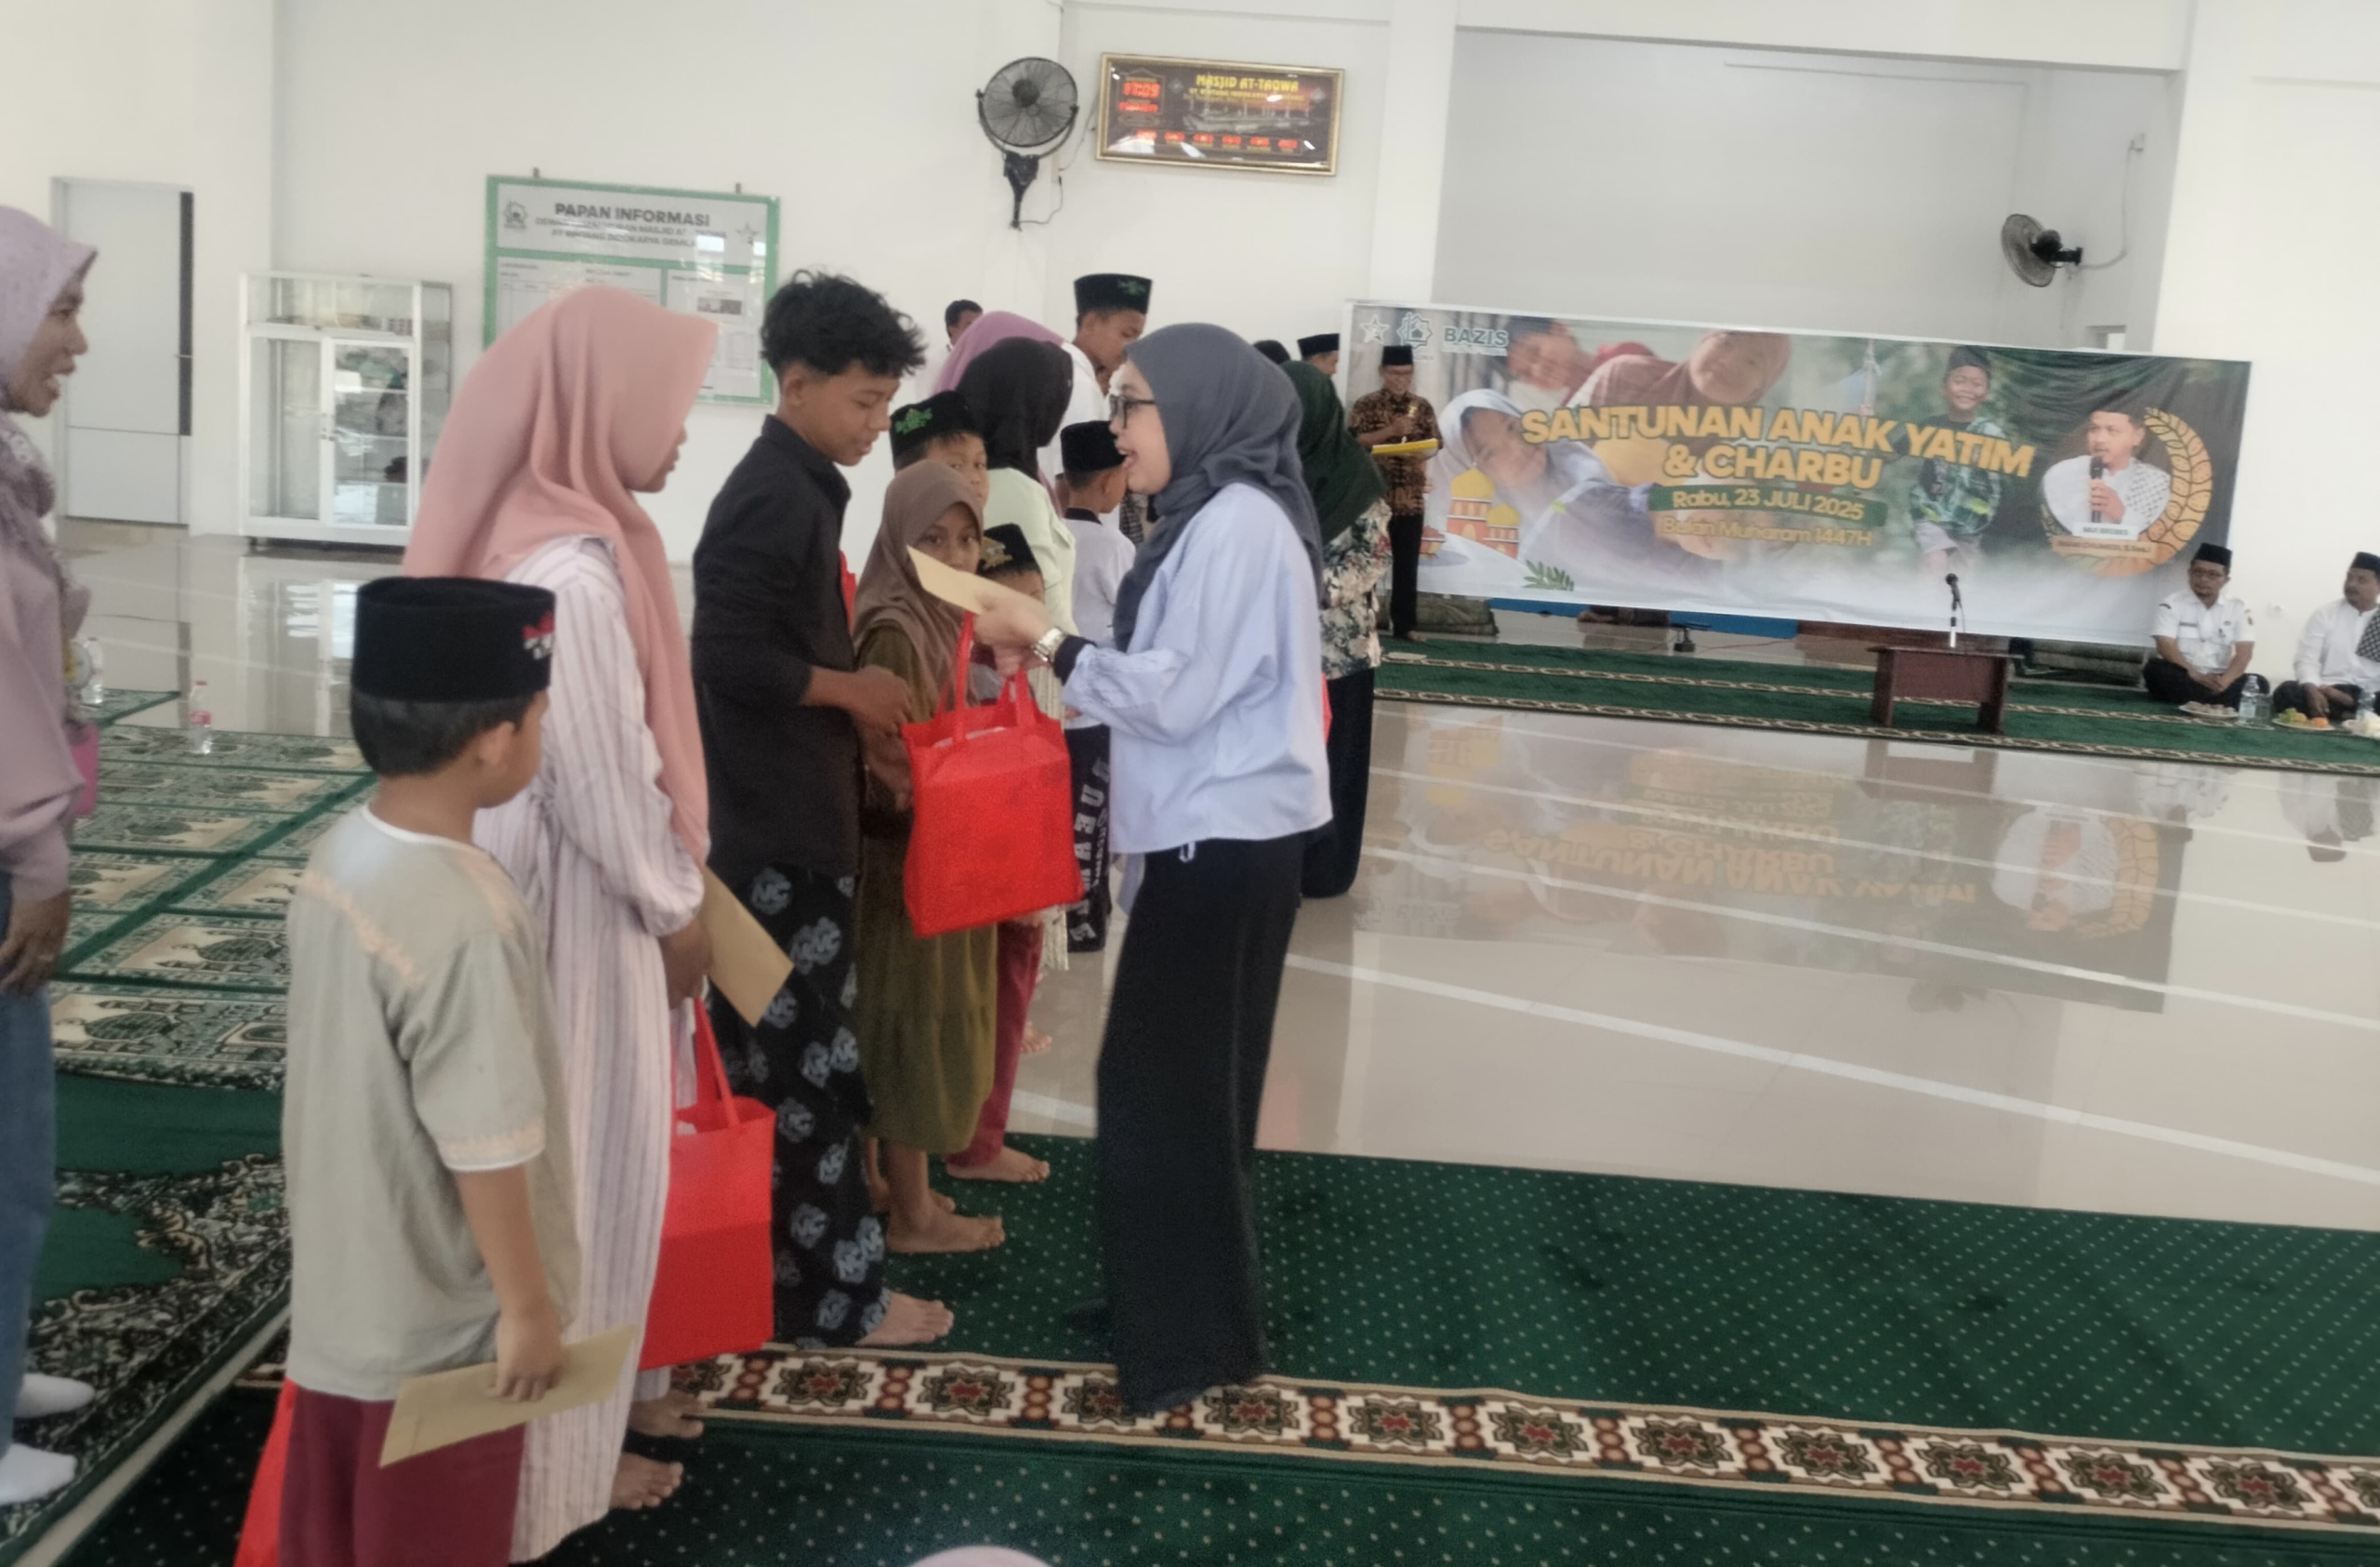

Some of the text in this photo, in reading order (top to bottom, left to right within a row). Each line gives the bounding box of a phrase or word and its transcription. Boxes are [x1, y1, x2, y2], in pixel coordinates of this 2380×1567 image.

[1196, 74, 1299, 92] MASJID AT-TAQWA
[555, 202, 612, 219] PAPAN
[615, 207, 710, 227] INFORMASI
[1443, 327, 1508, 346] BAZIS
[1522, 405, 2036, 477] SANTUNAN ANAK YATIM
[1663, 445, 1882, 489] & CHARBU
[1673, 488, 1864, 520] Rabu, 23 JULI 2025
